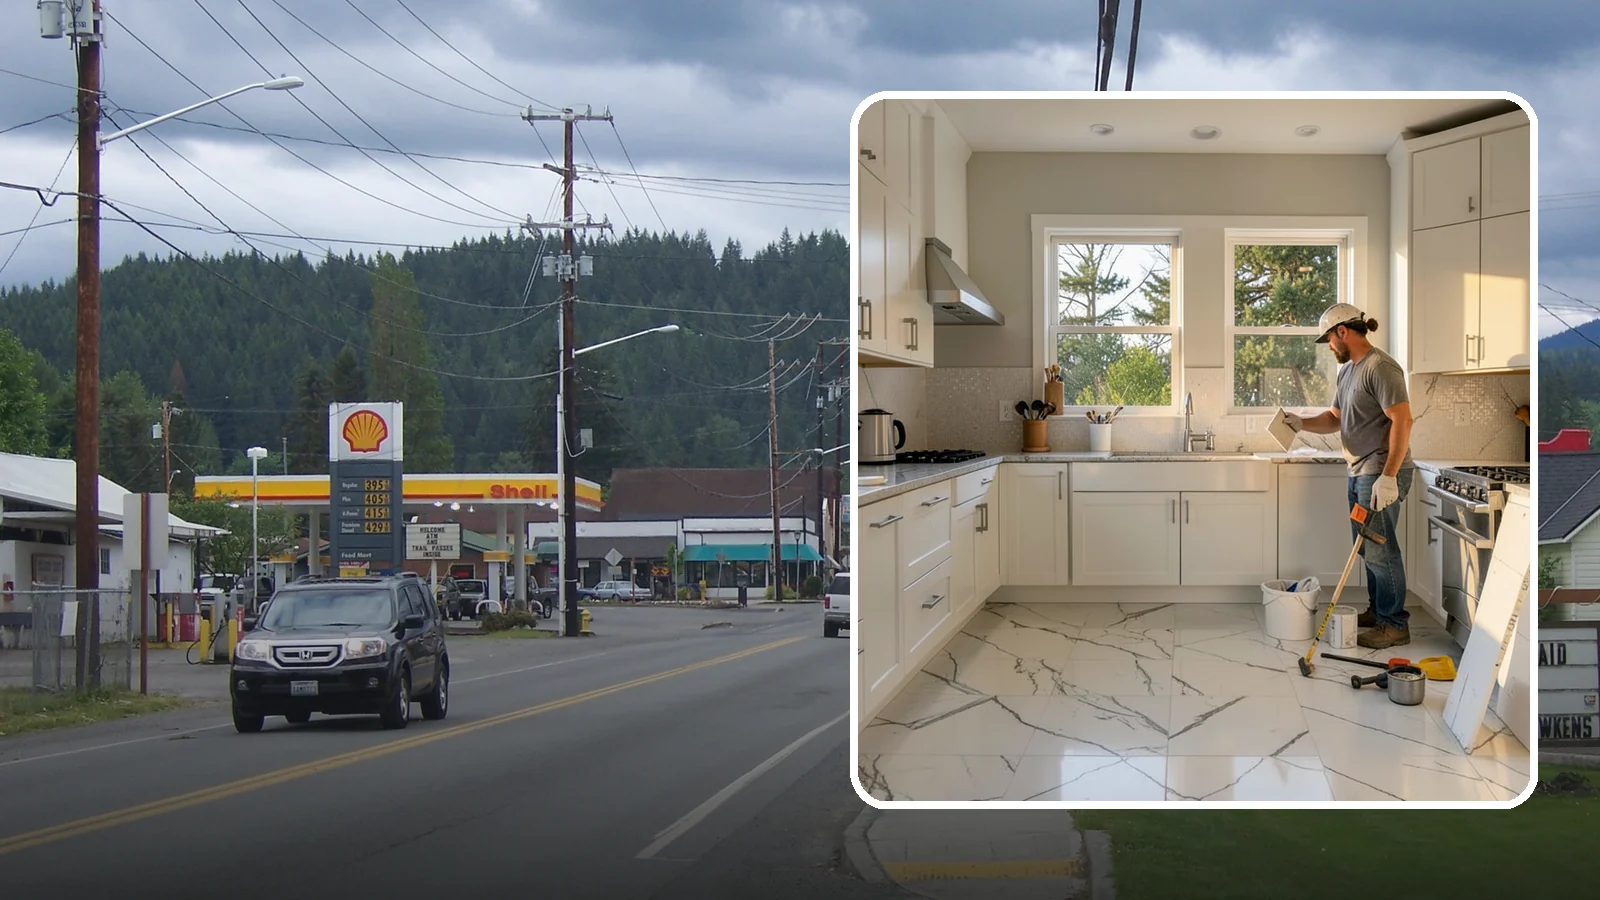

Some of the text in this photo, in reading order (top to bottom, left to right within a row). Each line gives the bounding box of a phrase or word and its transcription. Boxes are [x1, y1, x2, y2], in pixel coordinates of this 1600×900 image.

[365, 480, 384, 490] 395
[490, 484, 547, 499] Shell
[365, 494, 384, 504] 405
[365, 508, 384, 518] 415
[365, 522, 384, 533] 429
